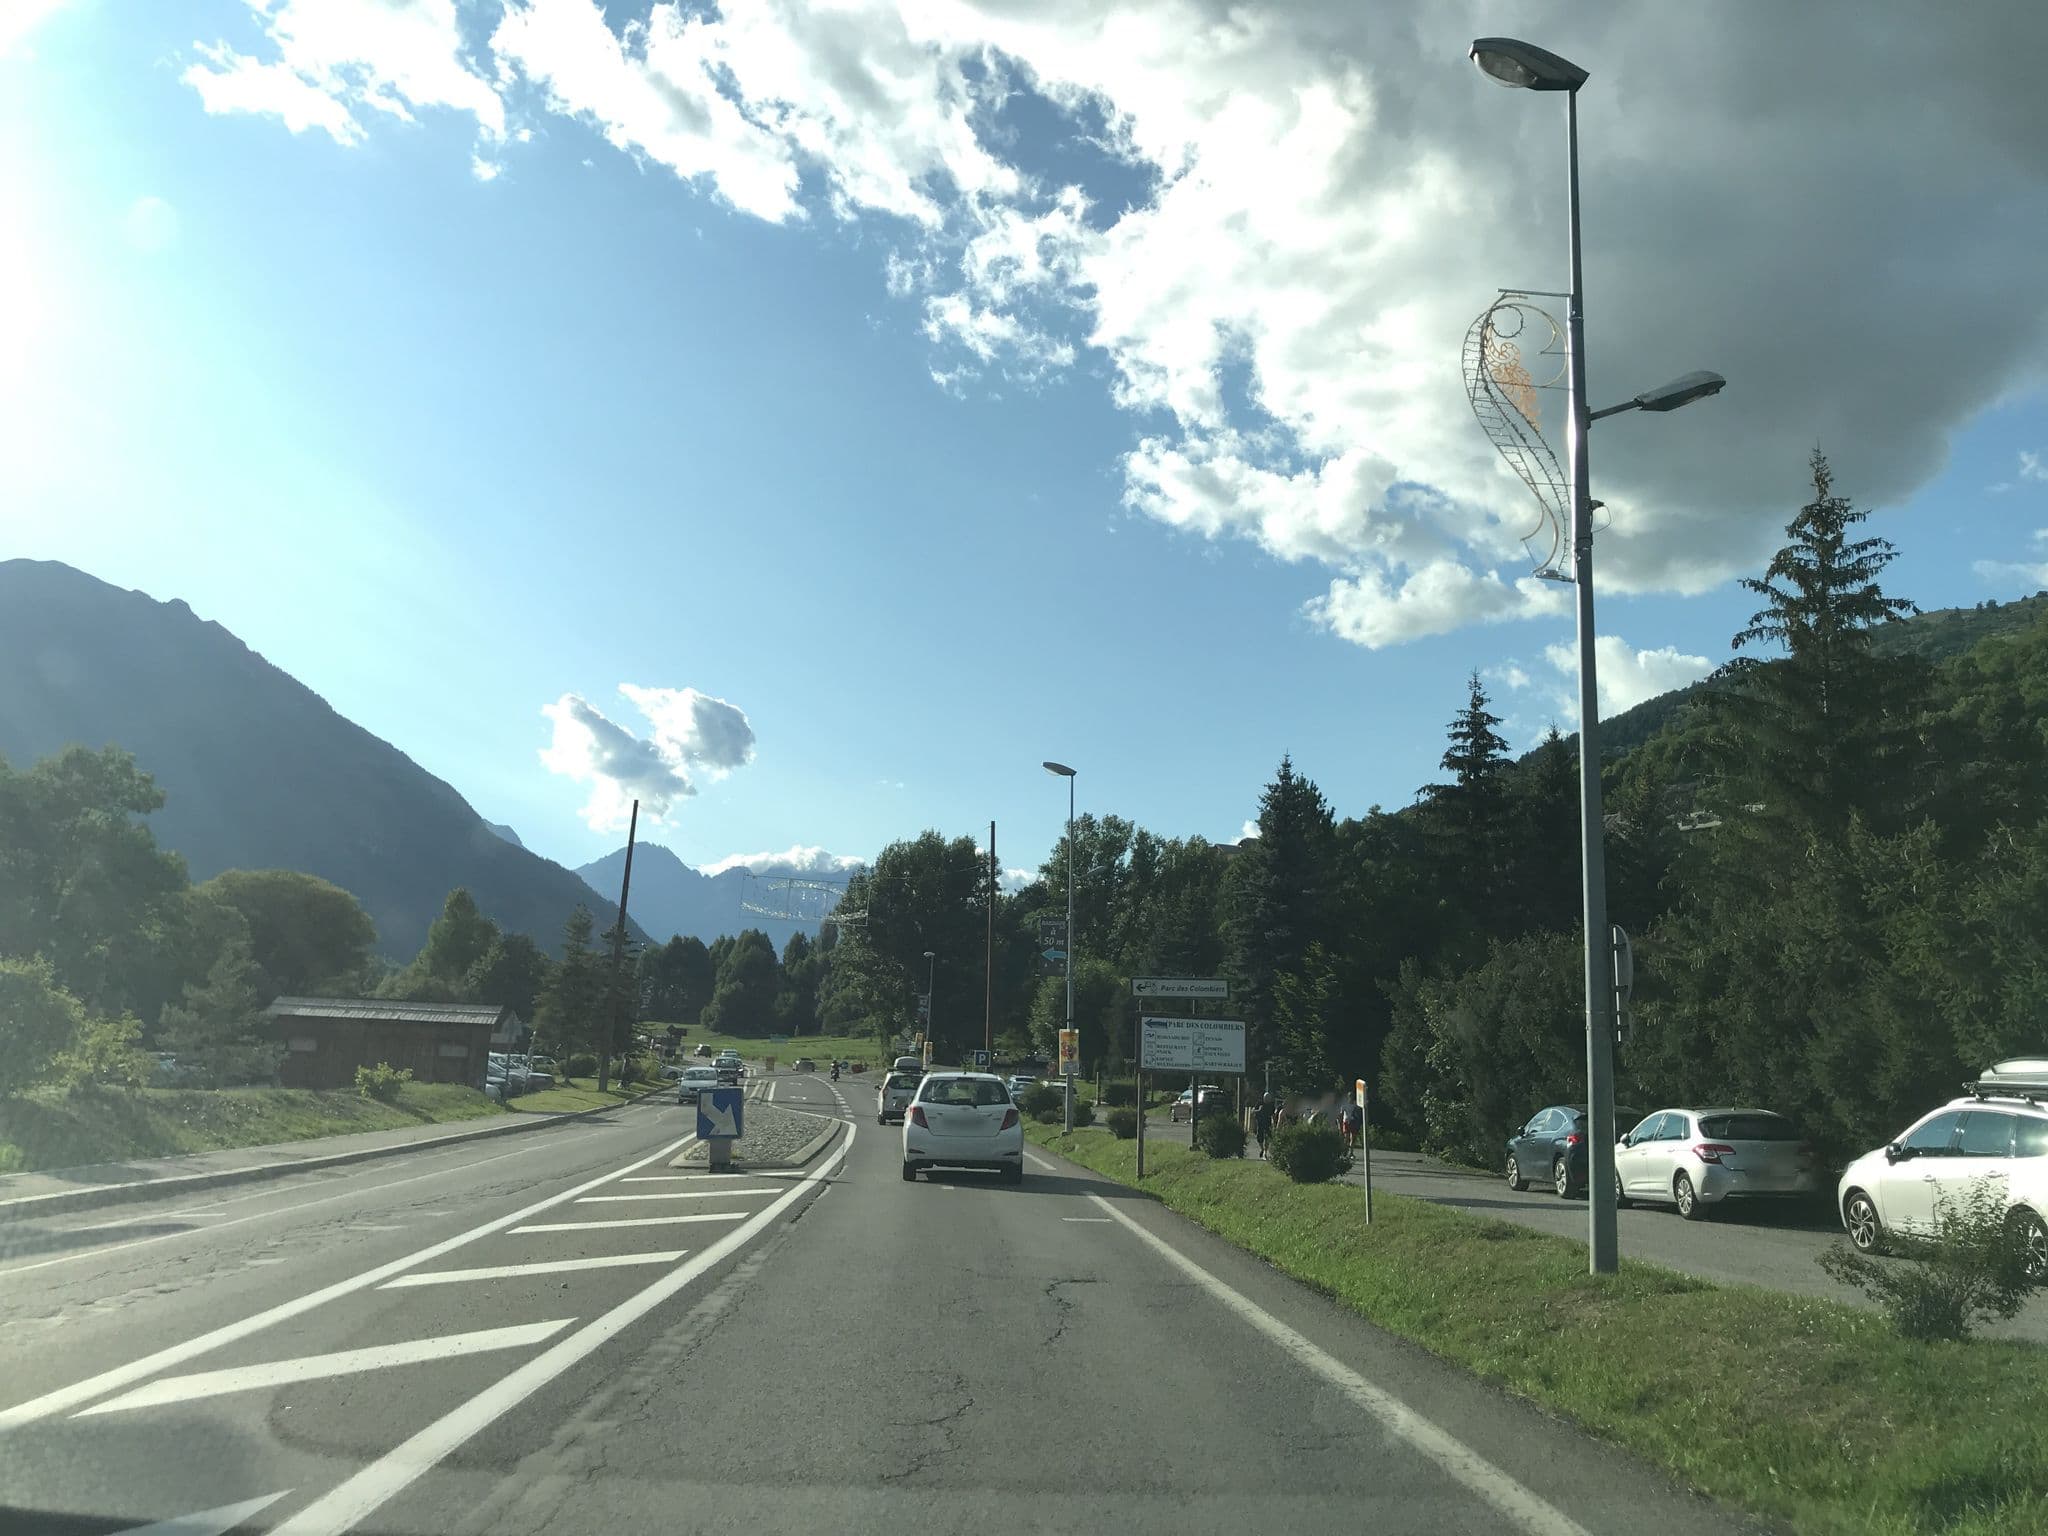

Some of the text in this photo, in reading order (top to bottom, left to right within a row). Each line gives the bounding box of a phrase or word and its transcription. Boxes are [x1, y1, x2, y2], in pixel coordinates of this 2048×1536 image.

[1044, 936, 1055, 946] 50
[1161, 984, 1225, 993] Parc des Colombiers
[1168, 1021, 1184, 1029] PARC
[1201, 1022, 1244, 1031] COLOMBIERS
[979, 1054, 986, 1064] P
